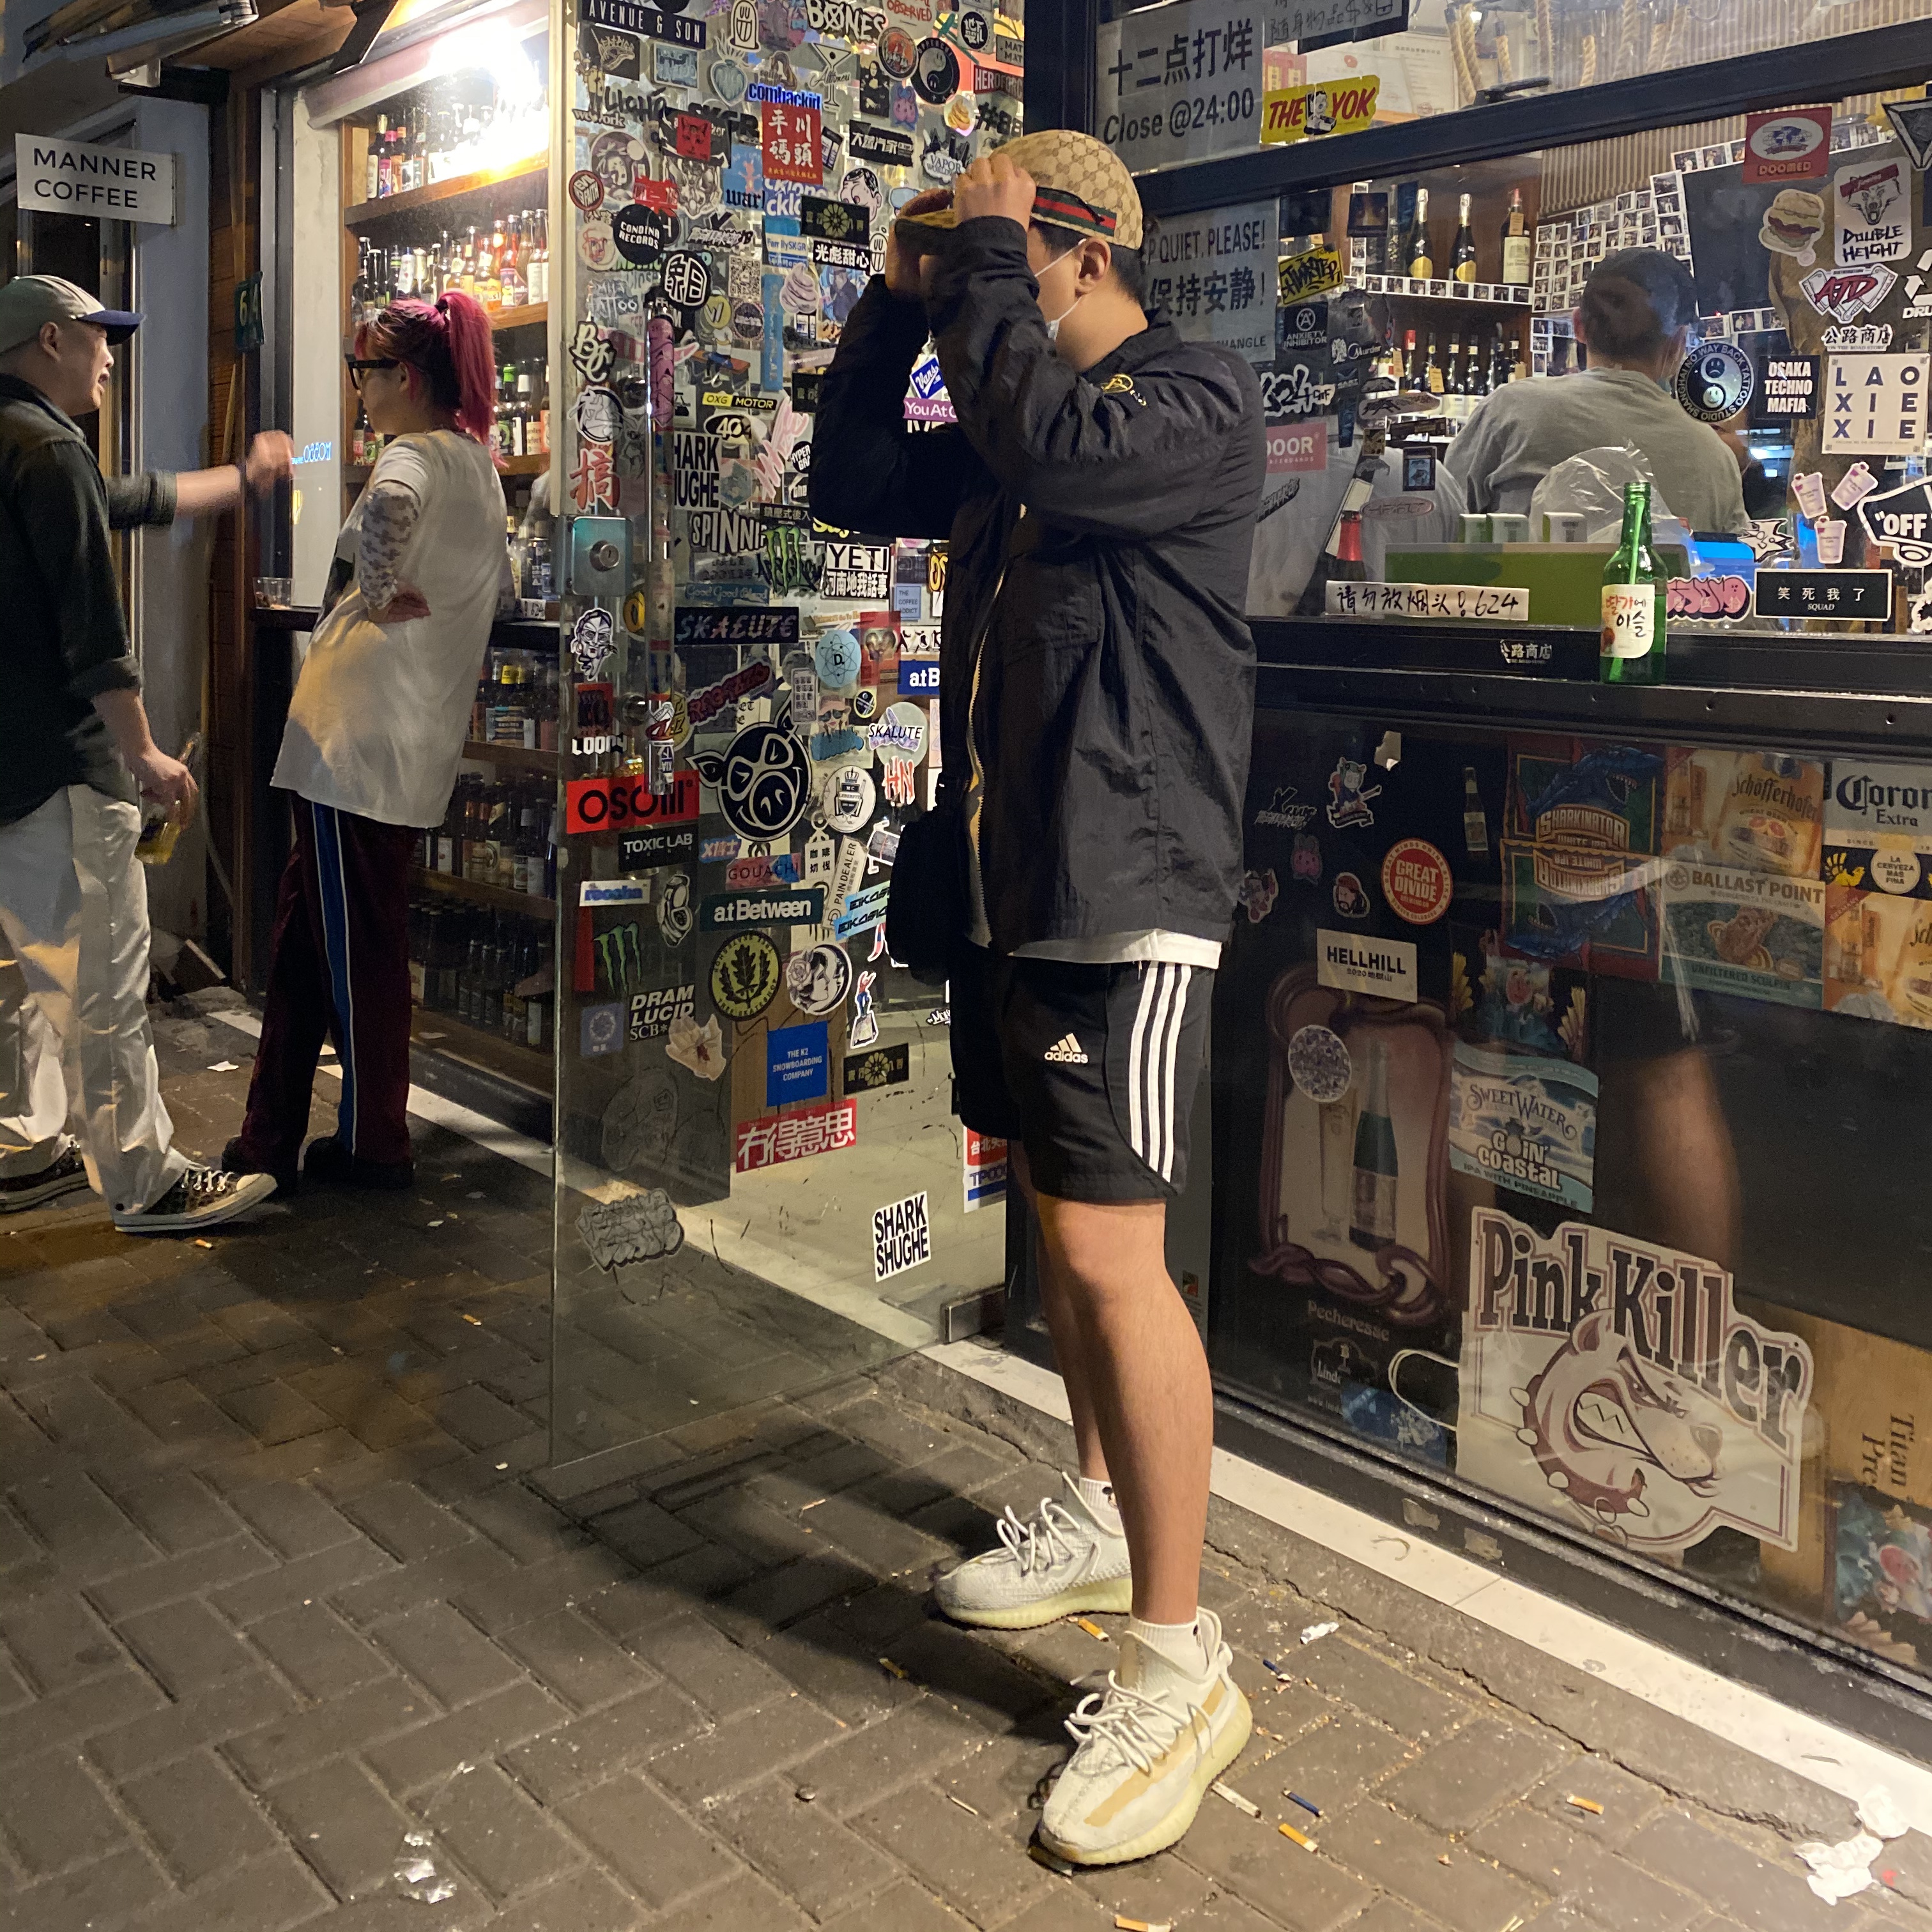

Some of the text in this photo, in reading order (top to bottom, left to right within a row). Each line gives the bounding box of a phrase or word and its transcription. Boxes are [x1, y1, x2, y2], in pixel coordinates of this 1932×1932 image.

[589, 0, 700, 43] AVENUE & SON
[1108, 18, 1254, 96] 十二点打烊
[1104, 88, 1254, 145] Close @24:00
[1269, 87, 1376, 130] THE YOK
[33, 148, 157, 181] MANNER
[1758, 161, 1812, 176] DOOMED
[34, 179, 139, 209] COFFEE
[619, 233, 659, 250] RECORDS
[1208, 219, 1266, 257] PLEASE!
[1842, 225, 1904, 245] DOUBLE
[815, 244, 871, 268] 光彪甜心
[1842, 242, 1904, 263] HEIGHT
[1284, 337, 1327, 348] INHIBITOR
[1287, 330, 1326, 341] ANXIETY
[1824, 325, 1891, 345] 公路商店
[1768, 361, 1811, 378] OSAKA
[1677, 344, 1752, 421] NO WAY BACK TATTOO STUDIO SHANGHAI
[1765, 379, 1813, 396] TECHNO
[706, 394, 774, 409] OXG MOTOR
[1767, 397, 1807, 413] MAFIA
[828, 544, 887, 572] YETI
[1475, 590, 1519, 617] 624
[1606, 595, 1646, 616] 딸기에
[1777, 586, 1866, 602] 笑死我了
[1807, 602, 1836, 611] SQUAD
[1616, 610, 1646, 638] 이슬
[869, 724, 923, 739] SKALUTE
[1539, 809, 1625, 848] SHARKINATOR
[1876, 808, 1919, 827] Extra
[623, 833, 693, 854] TOXIC LAB
[1395, 859, 1439, 884] GREAT
[1876, 862, 1915, 872] CERVEZA
[1394, 876, 1438, 903] DIVIDE
[1692, 869, 1766, 896] BALLAST
[1769, 881, 1824, 905] POINT
[1885, 876, 1905, 885] FINA
[1327, 945, 1406, 975] HELLHILL
[631, 985, 695, 1011] DRAM
[630, 1002, 695, 1027] LUCID
[772, 1056, 822, 1072] SNOWBOARDING
[787, 1047, 809, 1059] THE K2
[1044, 1050, 1088, 1064] adidas
[783, 1068, 813, 1082] COMPANY
[1484, 1169, 1512, 1184] WITH
[1514, 1179, 1578, 1207] PINEAPPLE
[874, 1194, 928, 1244] SHARK
[875, 1225, 930, 1279] SHUGHE
[1478, 1219, 1803, 1452] Pink Killer
[1889, 1411, 1915, 1488] Titan
